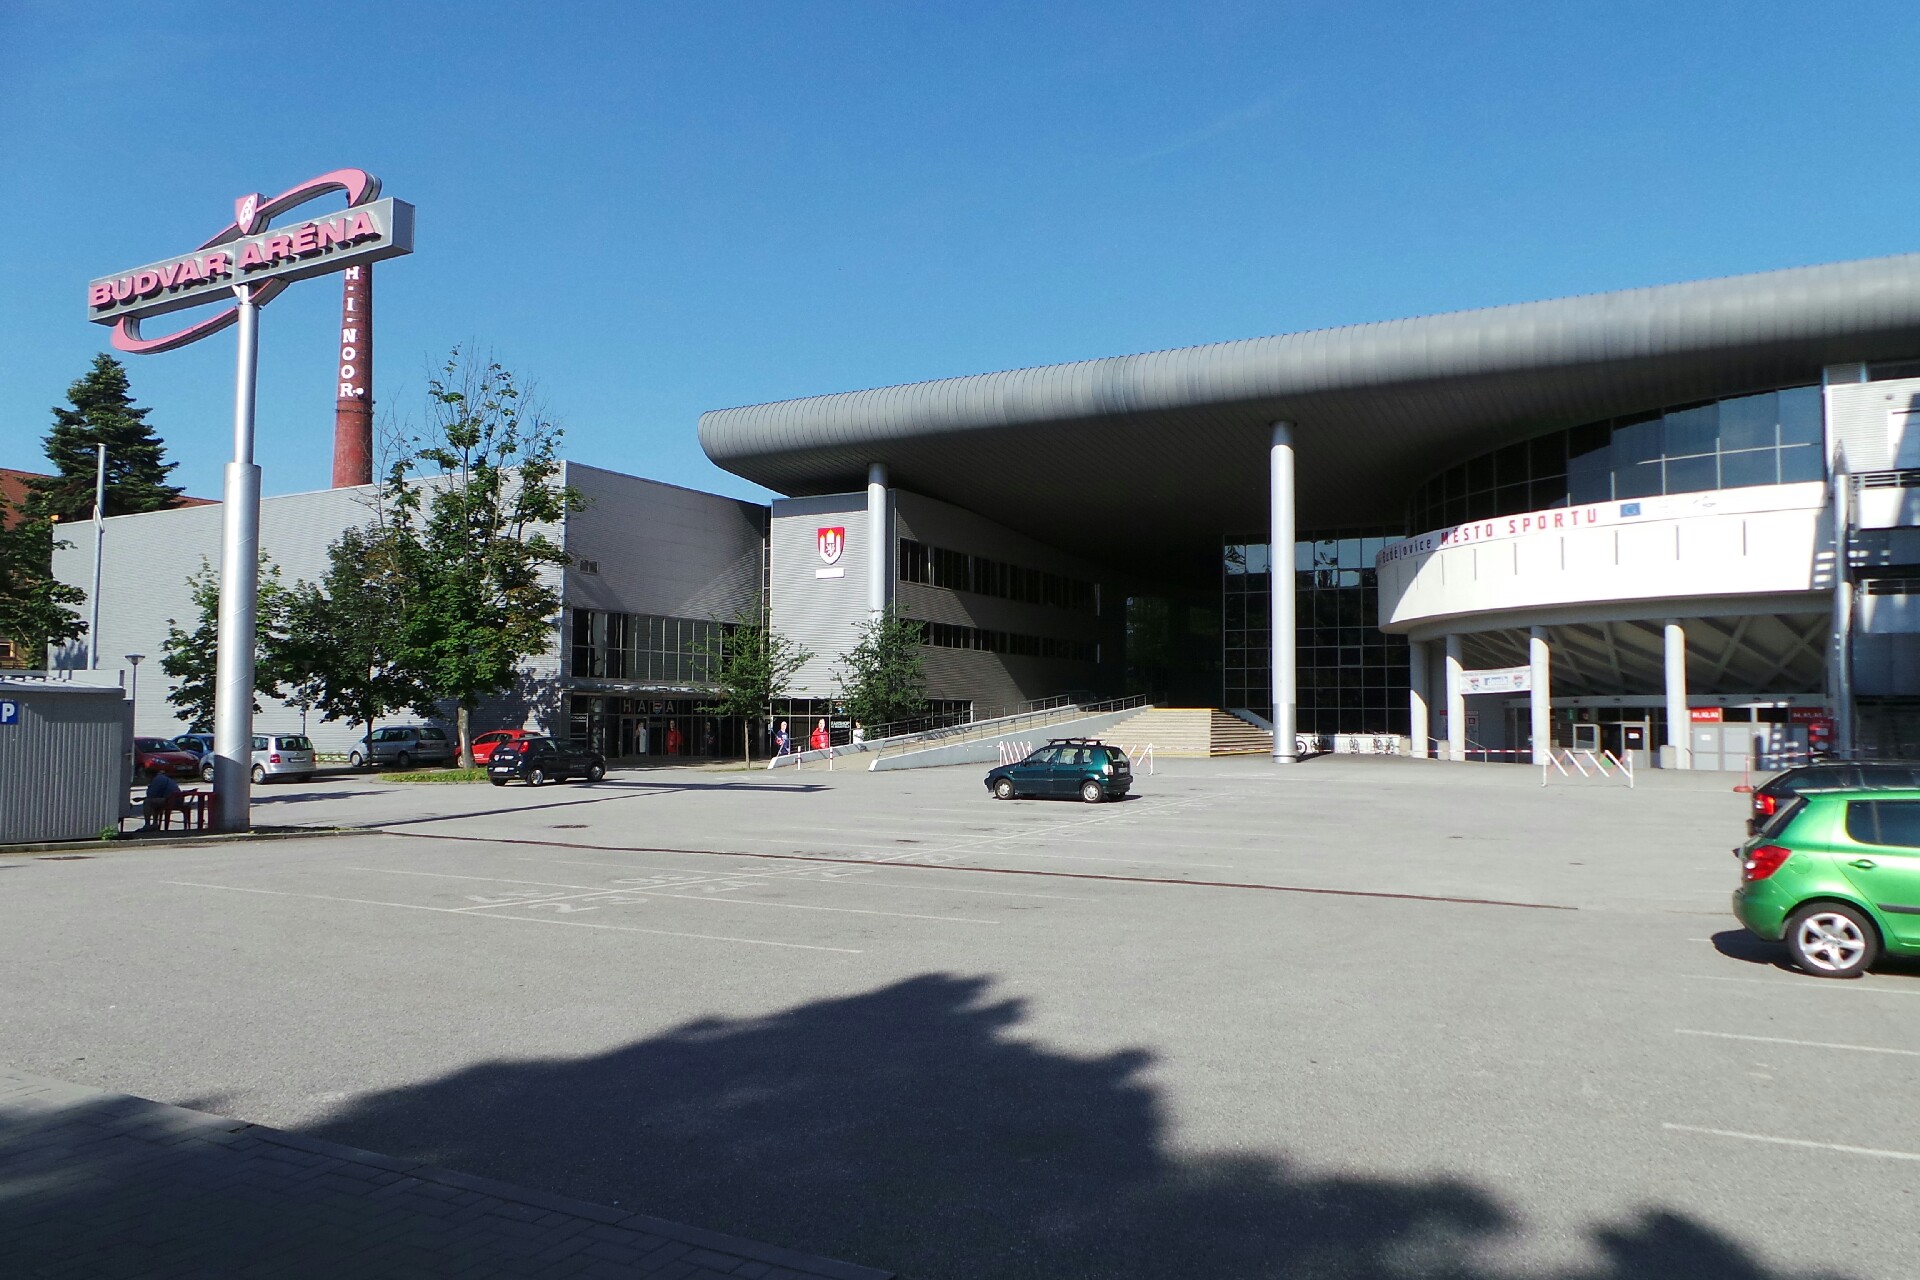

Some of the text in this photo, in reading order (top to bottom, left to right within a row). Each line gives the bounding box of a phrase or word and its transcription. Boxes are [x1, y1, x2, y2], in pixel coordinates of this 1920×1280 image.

[90, 211, 381, 309] BUDVAR ARÉNA
[1441, 523, 1493, 546] MĚSTO
[1509, 508, 1597, 534] SPORTU
[1, 703, 15, 722] P
